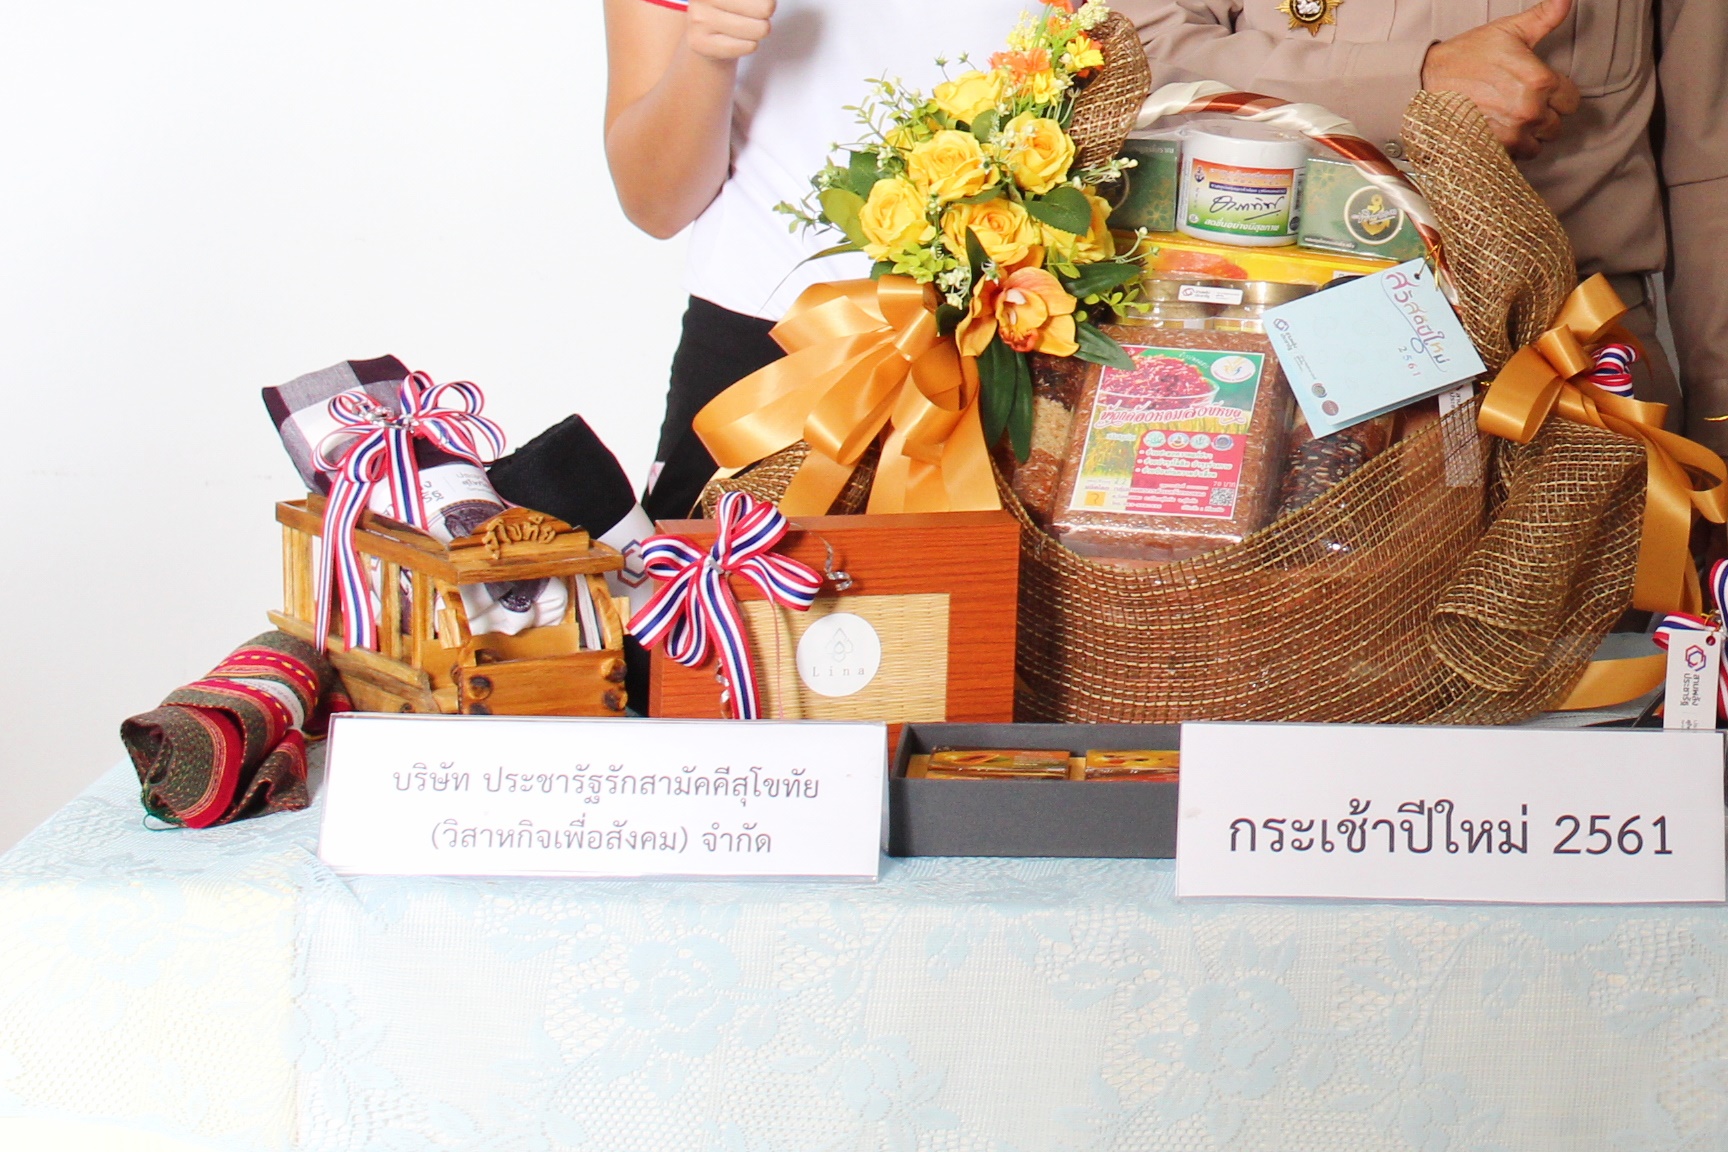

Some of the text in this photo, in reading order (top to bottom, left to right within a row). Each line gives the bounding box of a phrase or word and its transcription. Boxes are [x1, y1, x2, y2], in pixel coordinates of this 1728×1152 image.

[1398, 346, 1421, 377] 2561
[482, 515, 556, 559] สุโขทัย
[812, 666, 865, 678] Lina
[394, 762, 819, 807] บริษัท ประชารัฐรักสามัคคีสุโขทัย
[432, 813, 771, 853] (วิสาหกิจเพื่อสังคม) จำกัด
[1230, 798, 1672, 855] กระเช้าปีใหม่ 2561
